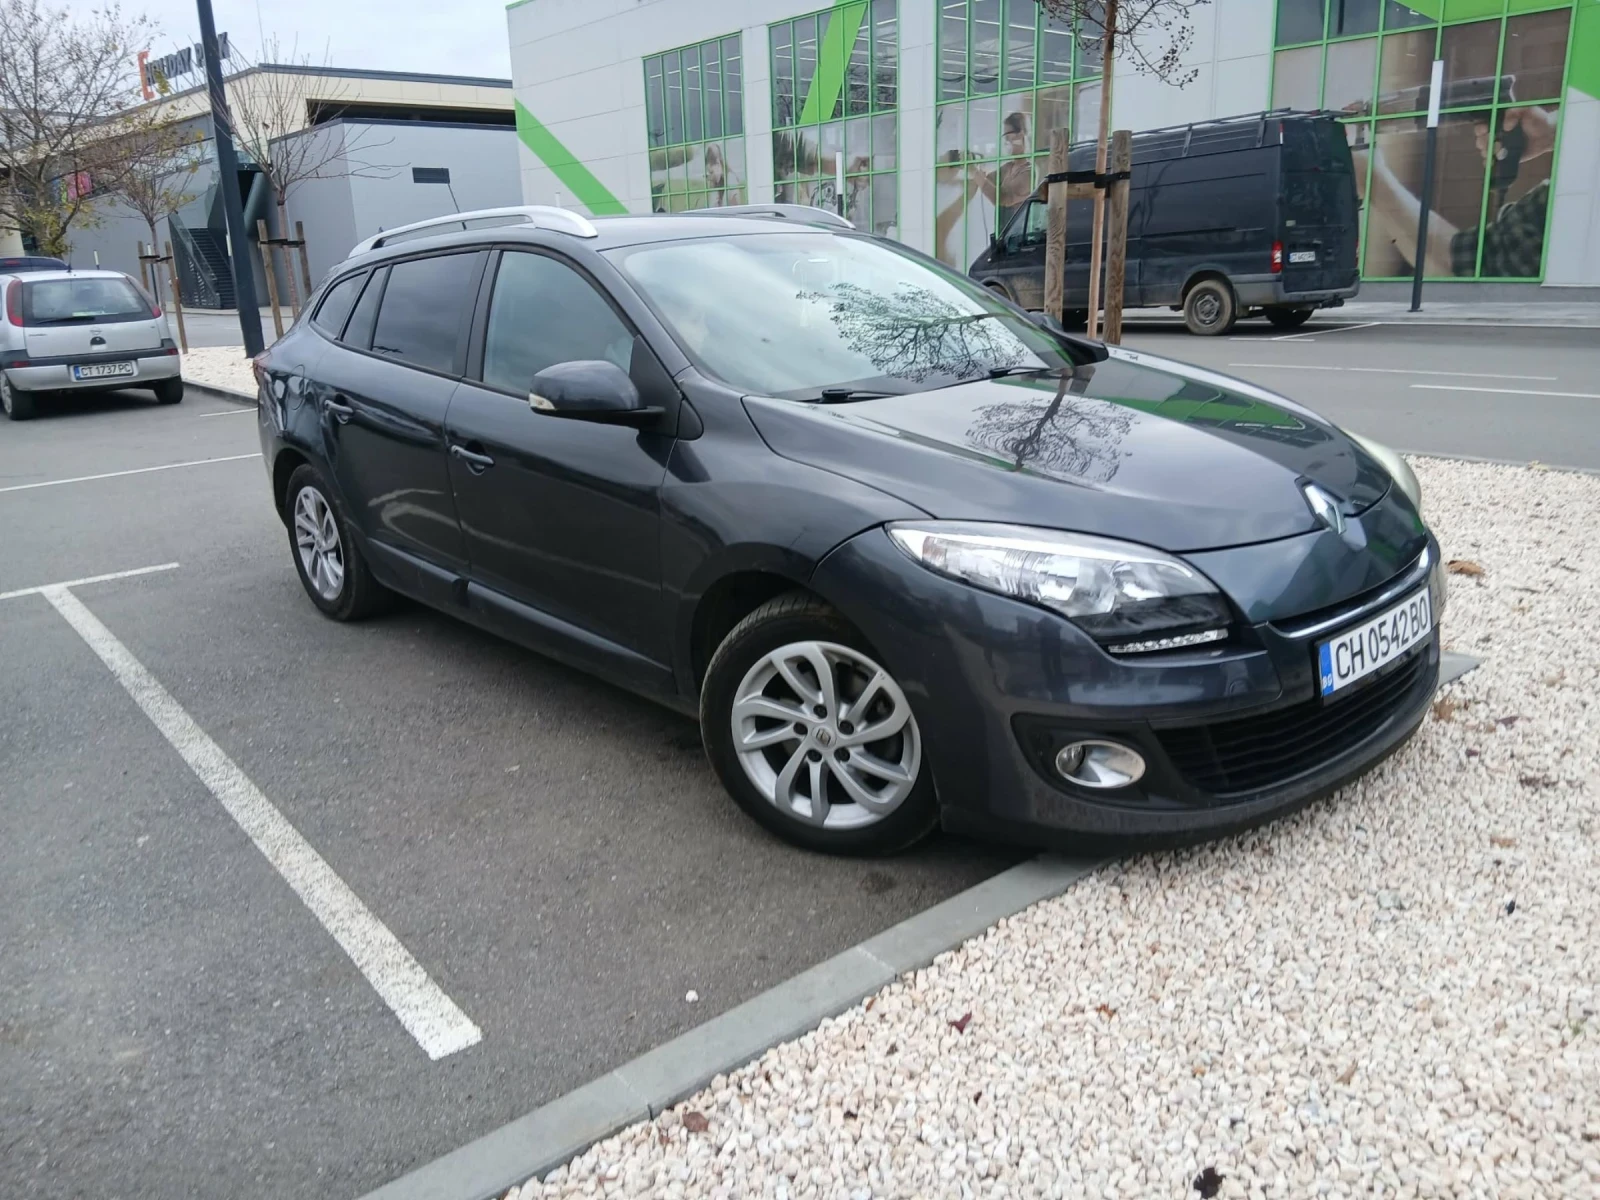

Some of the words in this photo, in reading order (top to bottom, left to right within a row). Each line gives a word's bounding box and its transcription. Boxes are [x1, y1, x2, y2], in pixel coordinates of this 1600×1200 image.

[194, 31, 231, 68] PK
[96, 364, 117, 376] 1737
[1335, 632, 1365, 679] CH
[1368, 609, 1409, 664] 0542
